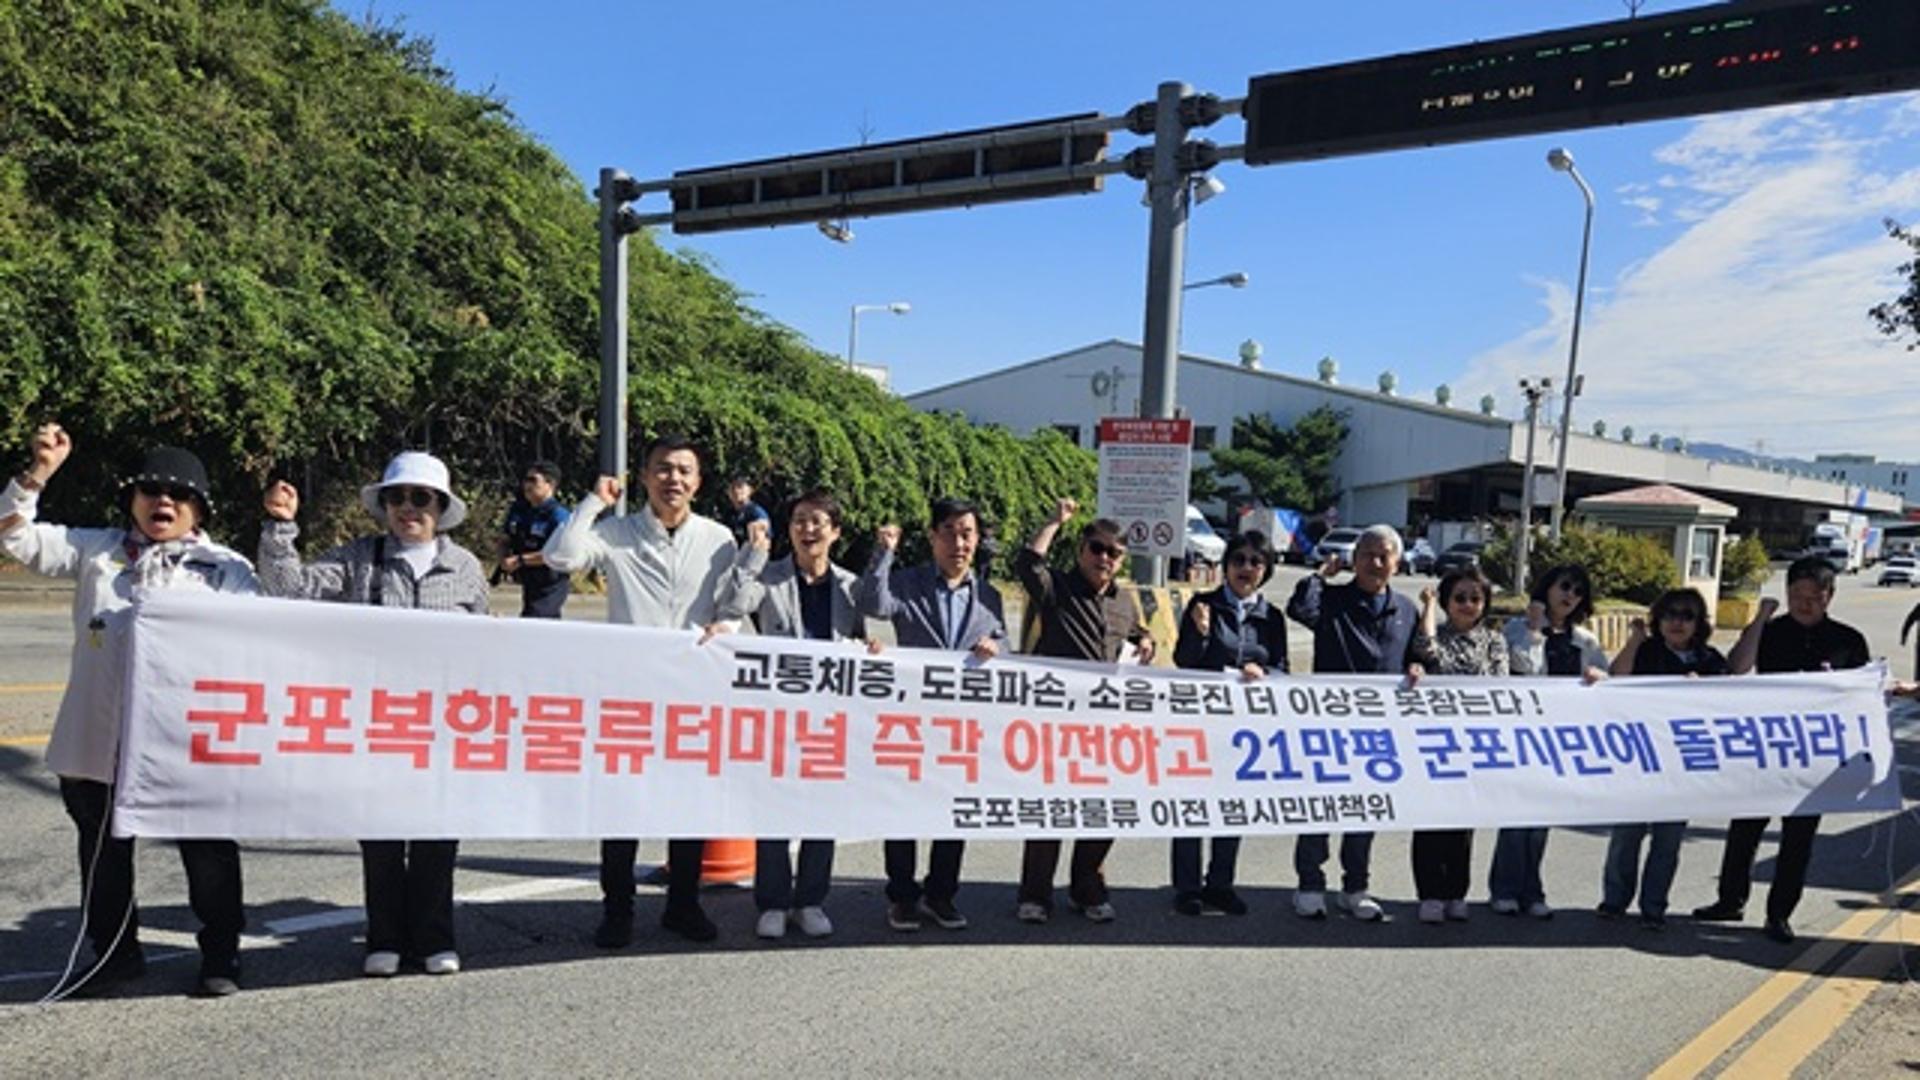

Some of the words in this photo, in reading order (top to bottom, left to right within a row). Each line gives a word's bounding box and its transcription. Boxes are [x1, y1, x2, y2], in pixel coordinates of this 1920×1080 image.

[732, 651, 906, 702] 교통체증,
[921, 666, 1076, 711] 도로파손,
[1245, 685, 1278, 715] 더
[1289, 687, 1385, 716] 이상은
[187, 679, 848, 778] 군포복합물류터미널
[873, 713, 984, 783] 즉각
[1003, 719, 1212, 786] 이전하고
[1232, 727, 1404, 784] 21만평
[1416, 721, 1661, 779] 군포시민에
[1669, 712, 1848, 771] 돌려줘라
[953, 797, 1140, 829] 군포복합물류
[1151, 799, 1211, 828] 이전
[1219, 793, 1396, 827] 범시민대책위
